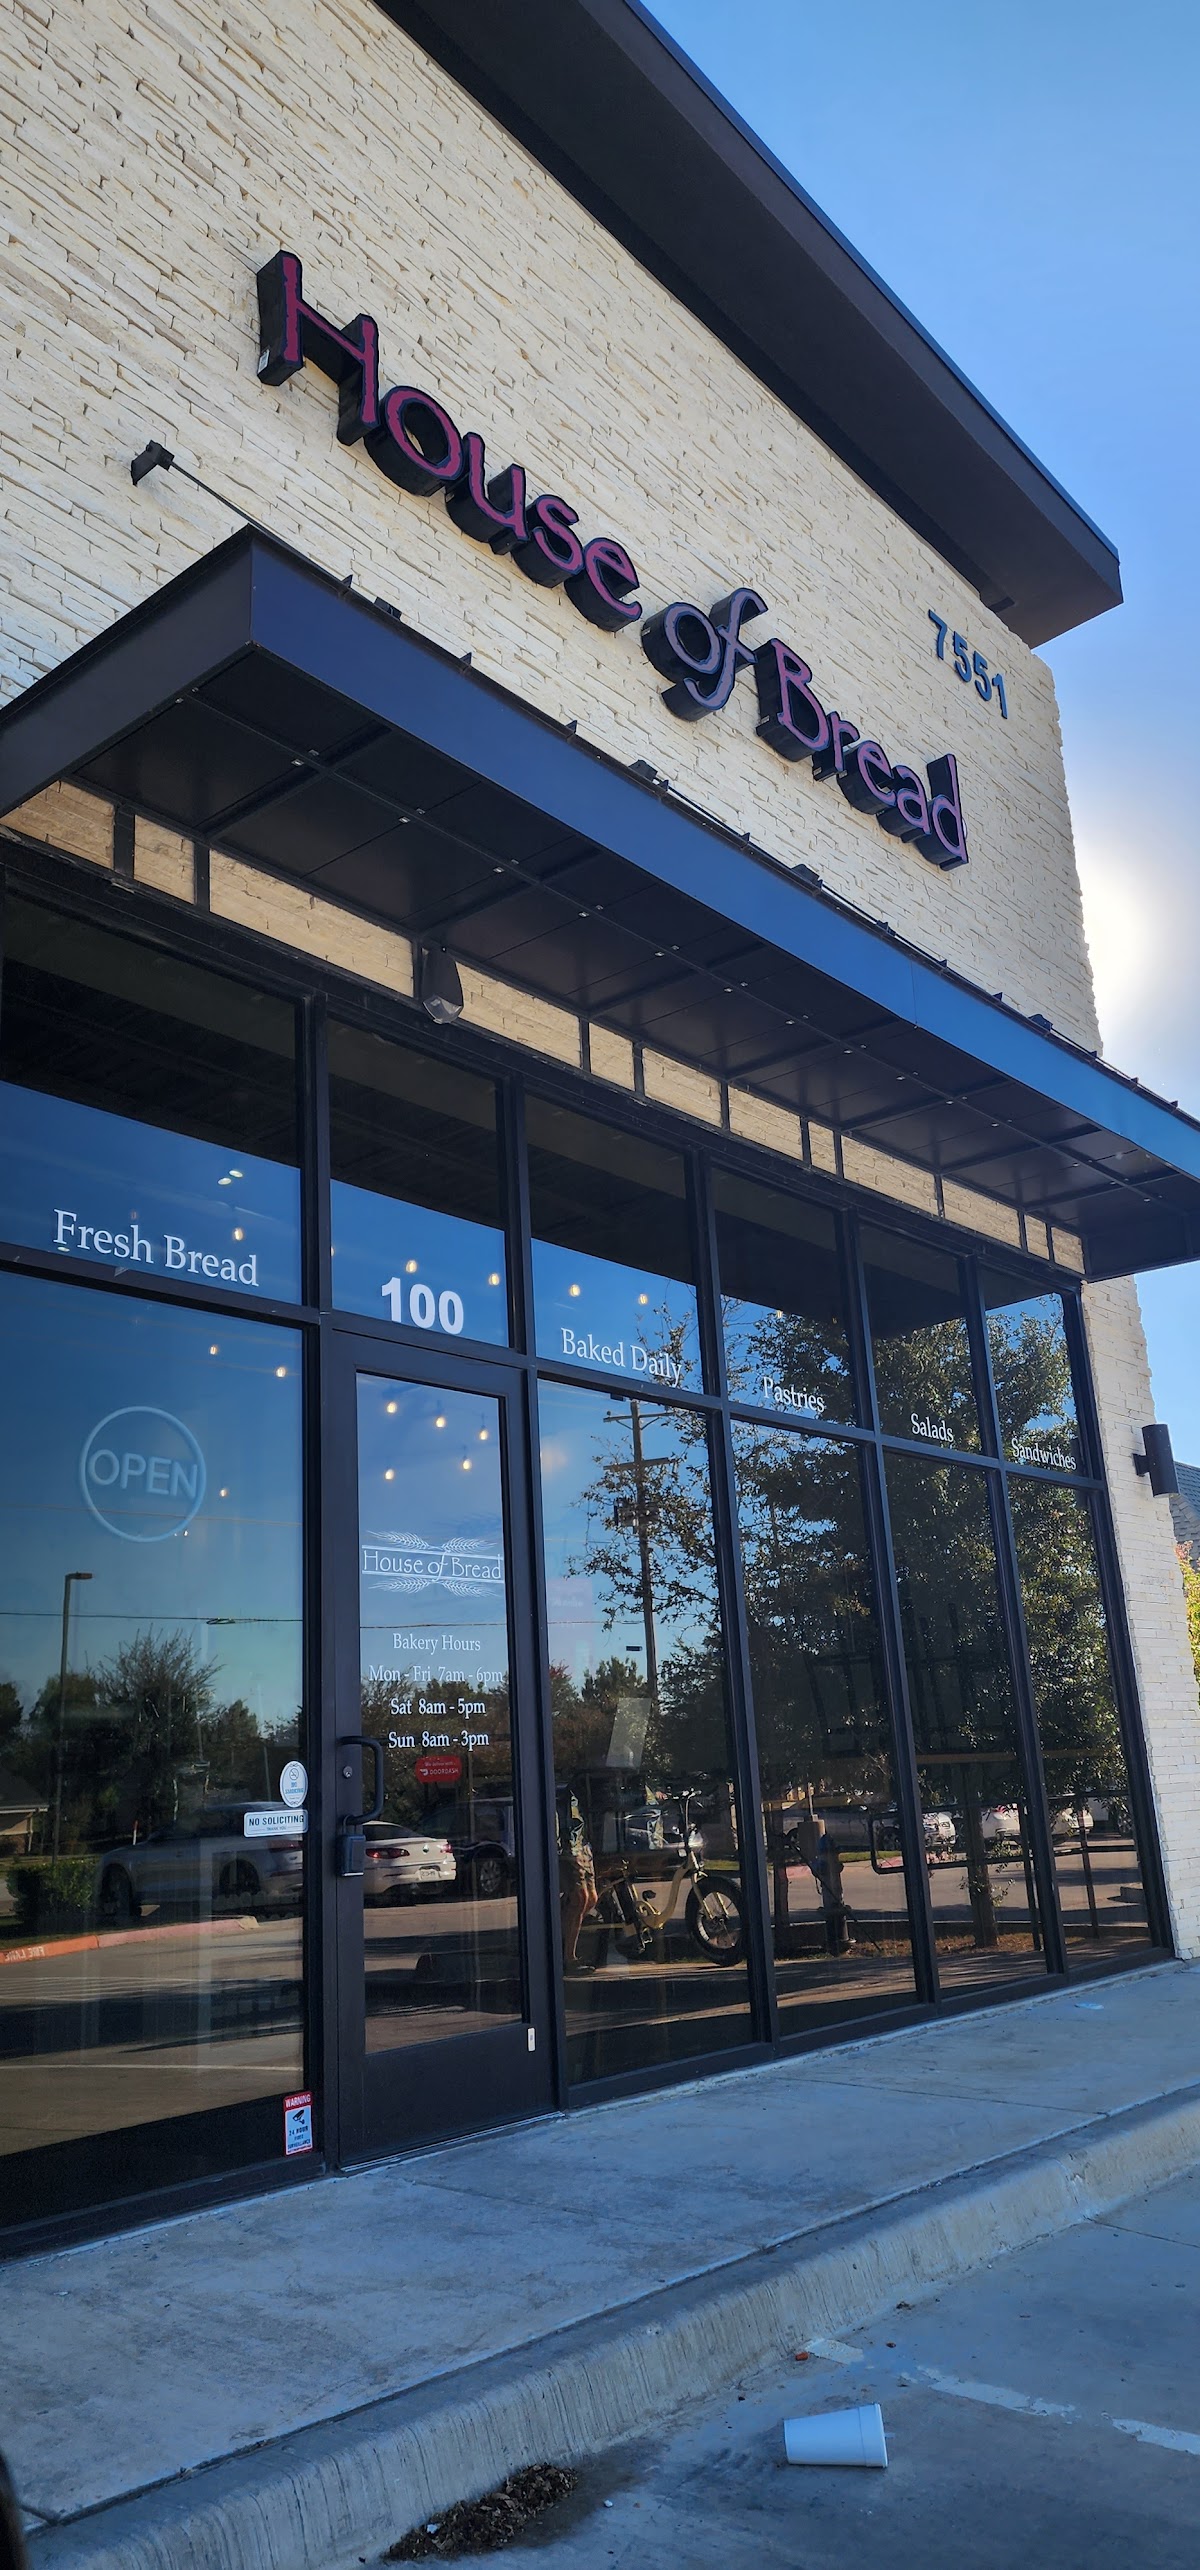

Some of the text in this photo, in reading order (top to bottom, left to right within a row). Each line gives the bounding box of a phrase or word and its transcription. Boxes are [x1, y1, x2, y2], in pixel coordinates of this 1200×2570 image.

[262, 251, 969, 868] House of Bread
[928, 609, 1008, 719] 7551
[53, 1208, 260, 1287] Fresh Bread
[381, 1276, 465, 1336] 100
[560, 1327, 682, 1388] Baked Daily
[763, 1376, 825, 1413] Pastries
[911, 1412, 955, 1443] Salads
[1011, 1437, 1077, 1470] Sandwiches
[88, 1449, 198, 1499] OPEN
[363, 1550, 501, 1582] House of Bread
[393, 1633, 481, 1655] Bakery Hours
[369, 1665, 401, 1682] Mon
[413, 1666, 431, 1682] Fri
[438, 1667, 465, 1682] 7am
[476, 1667, 503, 1687] 6pm
[390, 1698, 412, 1715] Sat
[418, 1698, 446, 1714] 8am
[457, 1698, 486, 1719] 5pm
[388, 1731, 415, 1749] Sun
[421, 1731, 450, 1748] 8am
[461, 1730, 490, 1751] 3pm
[249, 1814, 304, 1826] NO SOLICITING
[285, 2094, 311, 2108] WARNING
